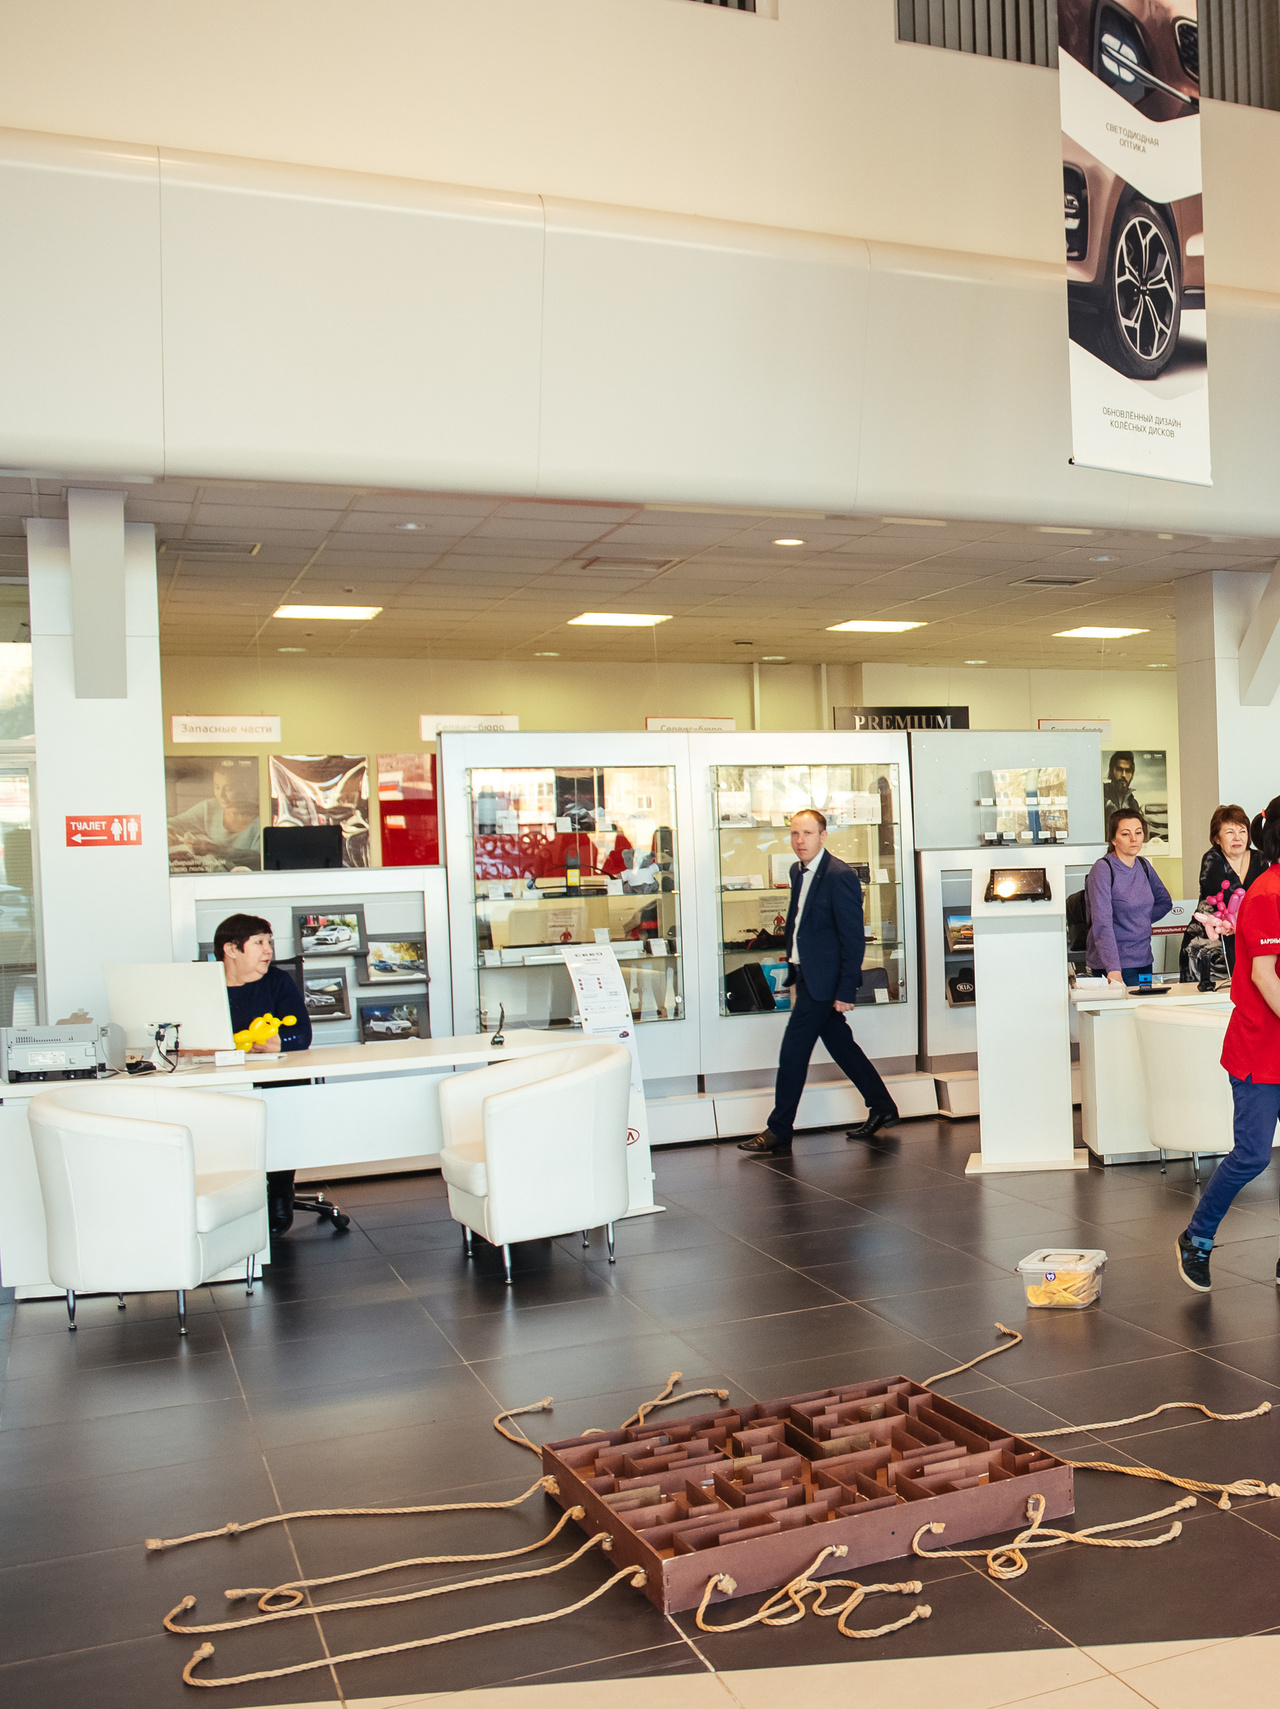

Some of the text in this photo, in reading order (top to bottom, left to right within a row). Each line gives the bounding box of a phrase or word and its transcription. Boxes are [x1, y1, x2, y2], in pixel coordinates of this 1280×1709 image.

[1105, 122, 1160, 147] СВЕТОДИОДНАЯ
[1119, 137, 1147, 153] ОПТИКА
[1154, 416, 1182, 428] ДИЗАЙН
[1147, 426, 1175, 438] ДИСКОВ
[181, 723, 272, 734] Запасные части
[853, 714, 953, 731] PREMIUM
[69, 821, 107, 831] ТУАЛЕТ
